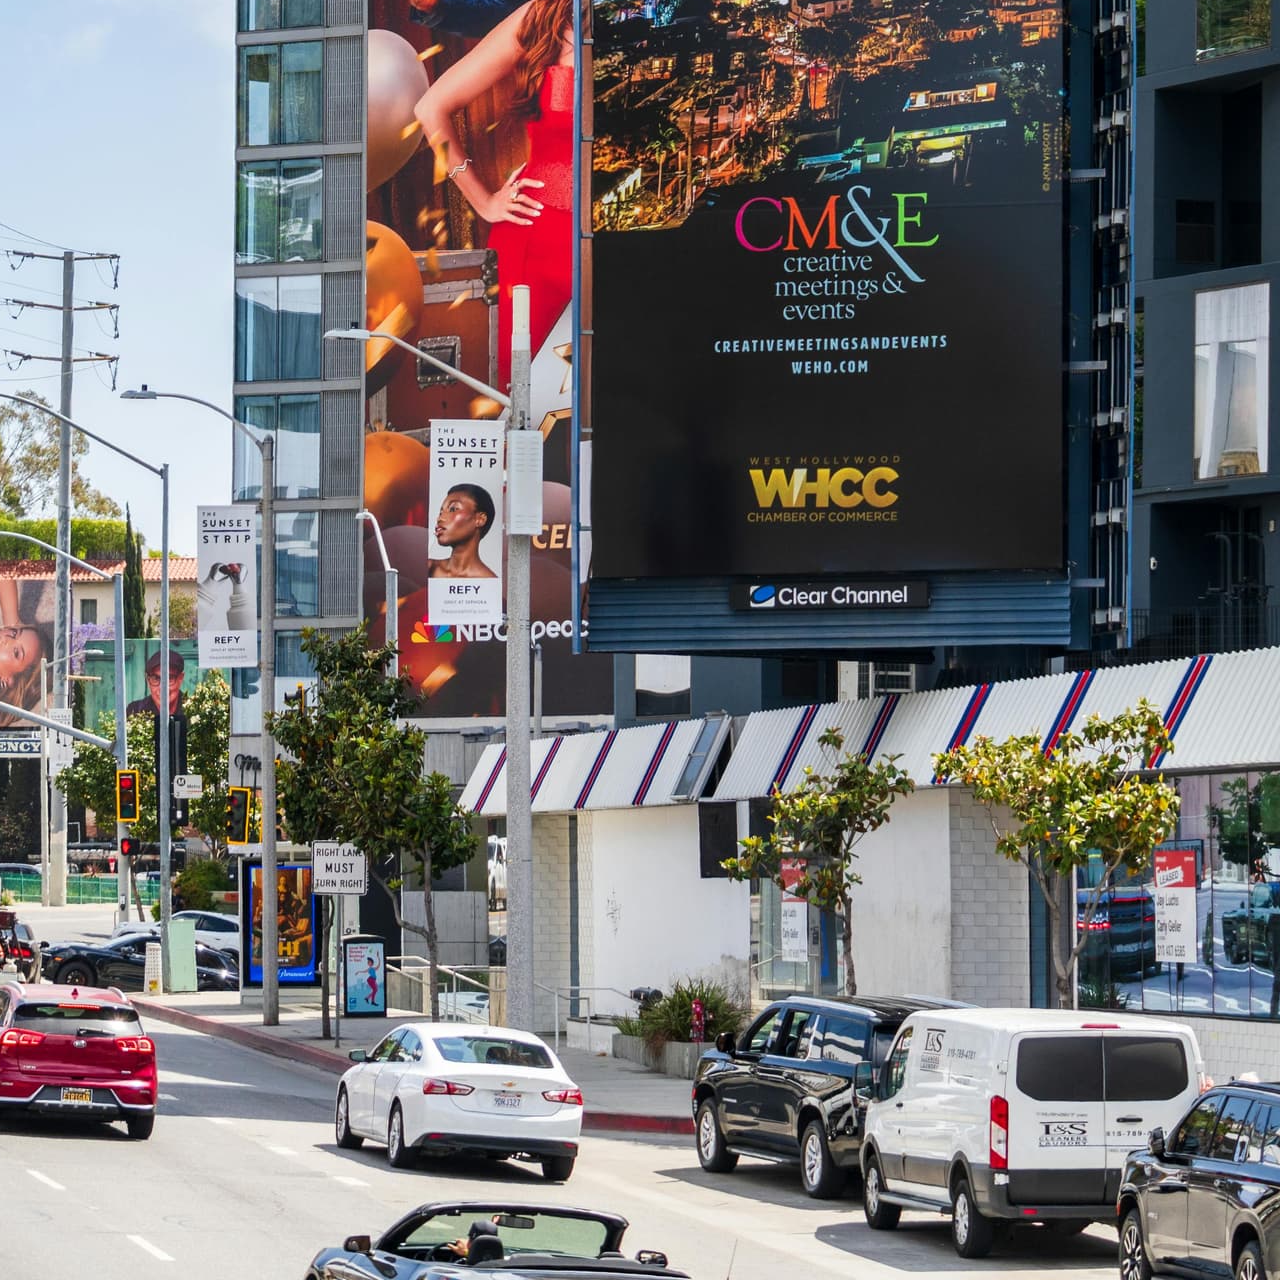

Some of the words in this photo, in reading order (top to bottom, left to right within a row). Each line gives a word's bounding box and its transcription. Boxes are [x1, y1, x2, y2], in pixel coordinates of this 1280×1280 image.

[734, 185, 940, 283] CM&E
[783, 250, 873, 272] creative
[775, 273, 879, 300] meetings
[882, 272, 908, 294] &
[782, 302, 856, 320] events
[714, 335, 948, 353] CREATIVEMEETINGSANDEVENTS
[791, 360, 869, 374] WEHO.COM
[437, 438, 498, 448] SUNSET
[438, 457, 497, 468] STRIP
[750, 457, 791, 465] WEST
[800, 455, 901, 464] HOLLYWOOD
[749, 466, 900, 508] WHCC
[747, 512, 807, 522] CHAMBER
[809, 512, 825, 522] OF
[828, 511, 898, 522] COMMERCE
[202, 519, 251, 528] SUNSET
[202, 535, 251, 544] STRIP
[449, 585, 481, 595] REFY
[778, 587, 828, 605] Clear
[831, 585, 908, 604] Channel
[214, 636, 241, 644] REFY
[530, 620, 590, 648] peac
[316, 848, 339, 857] RIGHT
[342, 848, 363, 857] LANE
[325, 863, 355, 874] MUST
[1160, 870, 1179, 885] LEASED
[315, 879, 337, 888] TURN
[339, 879, 363, 889] RIGHT
[279, 942, 300, 956] HI
